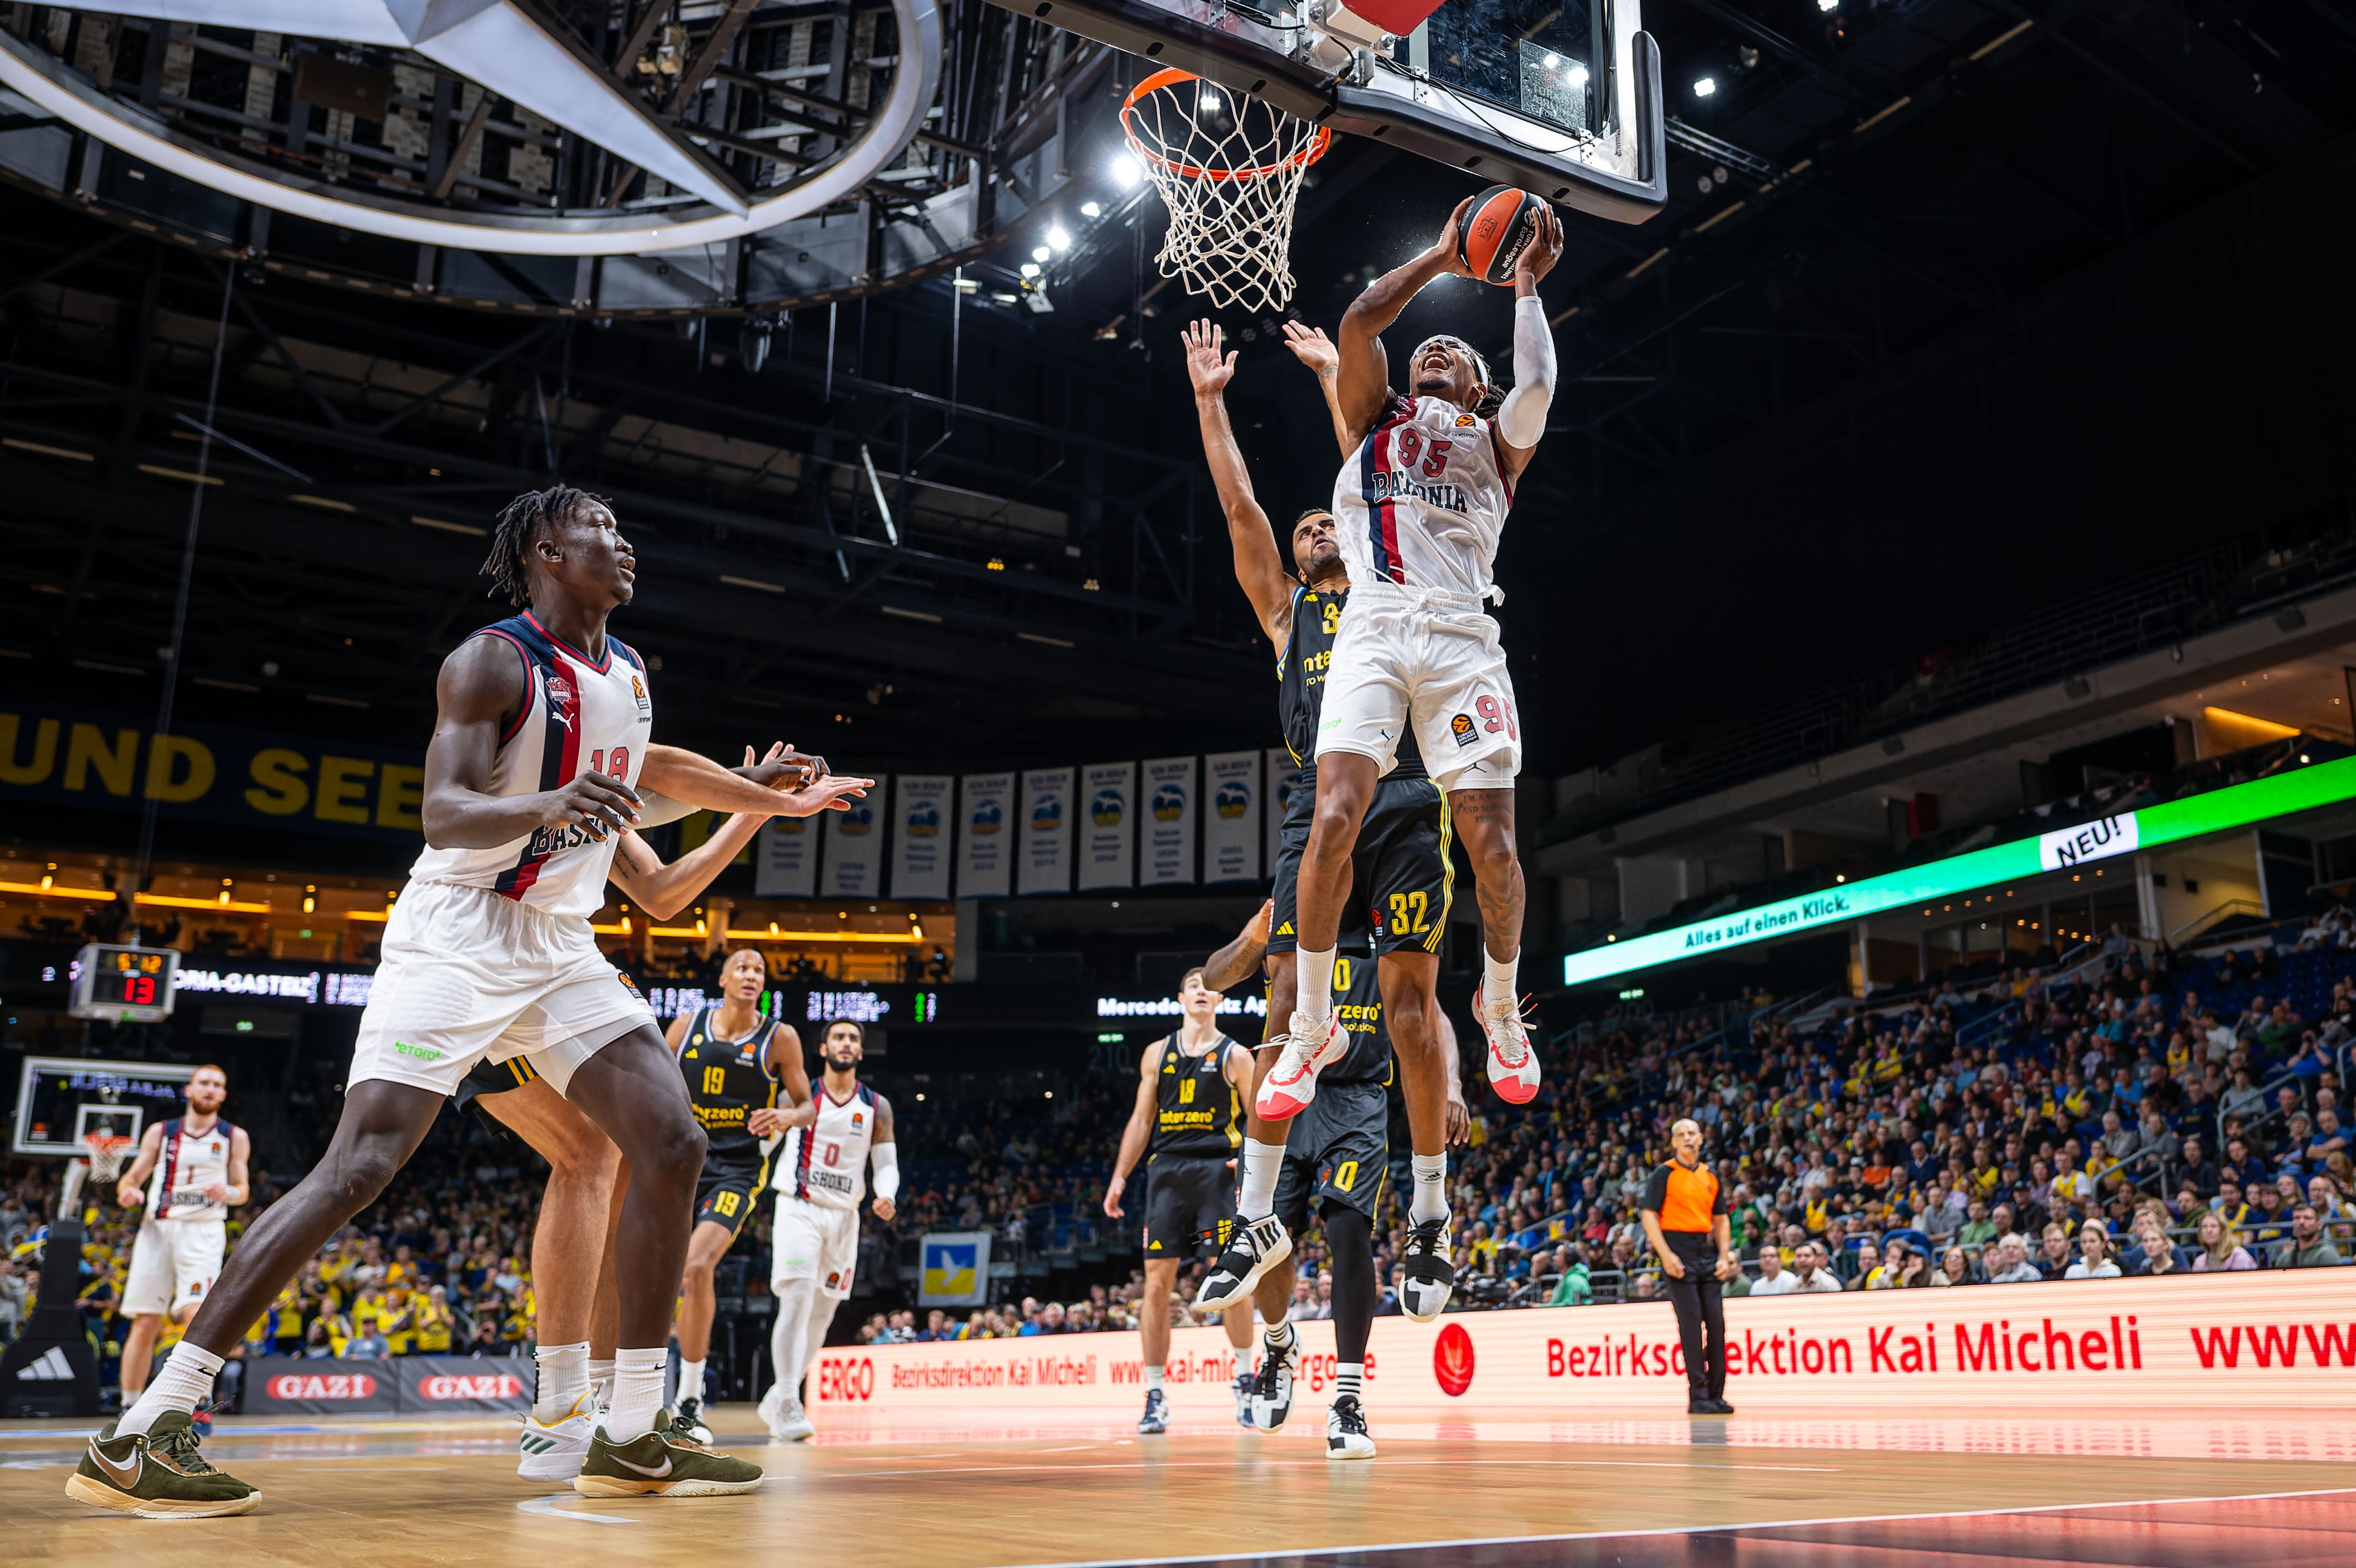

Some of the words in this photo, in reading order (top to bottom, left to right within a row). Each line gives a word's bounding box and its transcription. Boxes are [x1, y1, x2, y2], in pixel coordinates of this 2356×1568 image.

[1502, 226, 1528, 268] EuroLeague
[1398, 428, 1453, 477] 95
[1322, 603, 1343, 634] 3
[1475, 695, 1516, 741] 95
[0, 712, 216, 802] UND
[591, 747, 629, 783] 18
[2057, 817, 2121, 867] NEU!
[1390, 892, 1429, 935] 32
[1686, 929, 1721, 948] Alles
[1726, 918, 1750, 938] auf
[1754, 910, 1798, 932] einen
[1802, 894, 1850, 920] Klick.
[118, 978, 155, 1005] 13
[1334, 959, 1351, 991] 0
[703, 1066, 725, 1094] 19
[1179, 1078, 1196, 1104] 18
[824, 1143, 840, 1167] 0
[187, 1165, 195, 1184] 1
[1334, 1161, 1359, 1192] 0
[713, 1191, 740, 1217] 19
[1867, 1322, 1937, 1373] Kai
[1954, 1316, 2142, 1372] Micheli
[820, 1358, 874, 1401] ERGO
[892, 1359, 1003, 1388] Bezirksdirektion
[1007, 1357, 1033, 1386] Kai
